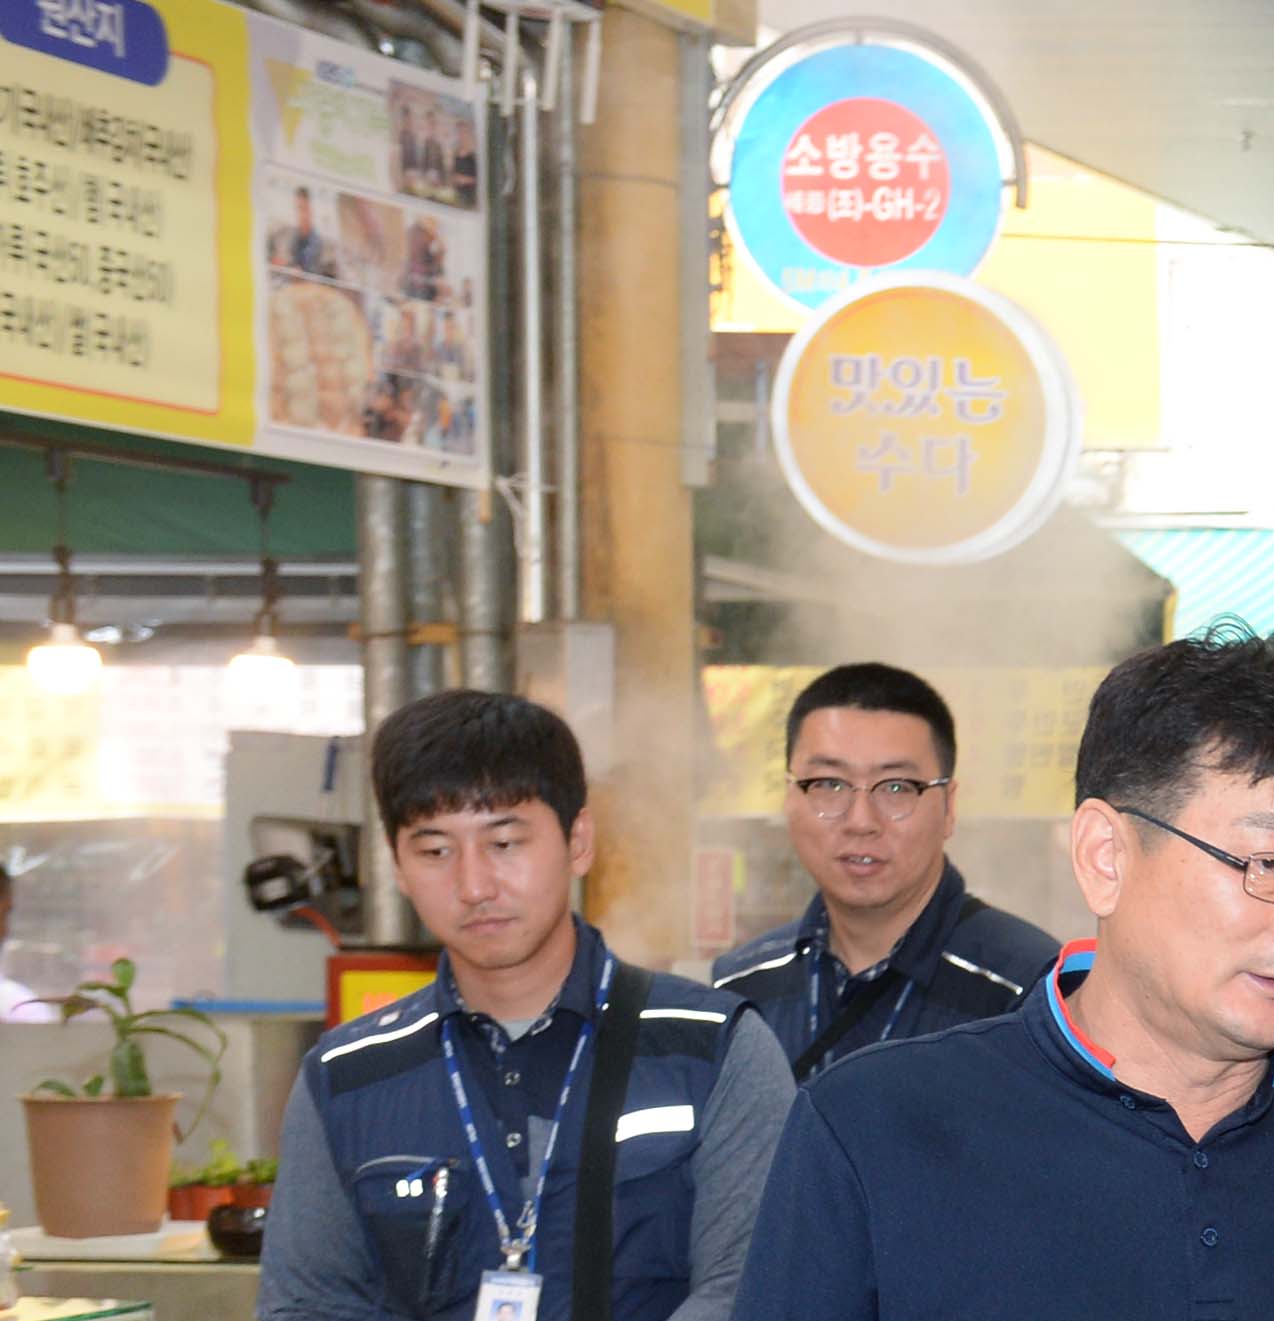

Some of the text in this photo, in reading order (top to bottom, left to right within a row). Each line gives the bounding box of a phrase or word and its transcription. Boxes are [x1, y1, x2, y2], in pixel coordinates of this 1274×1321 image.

[785, 131, 943, 181] 소방용수
[828, 354, 1004, 424] 맛있는
[853, 430, 979, 496] 수다
